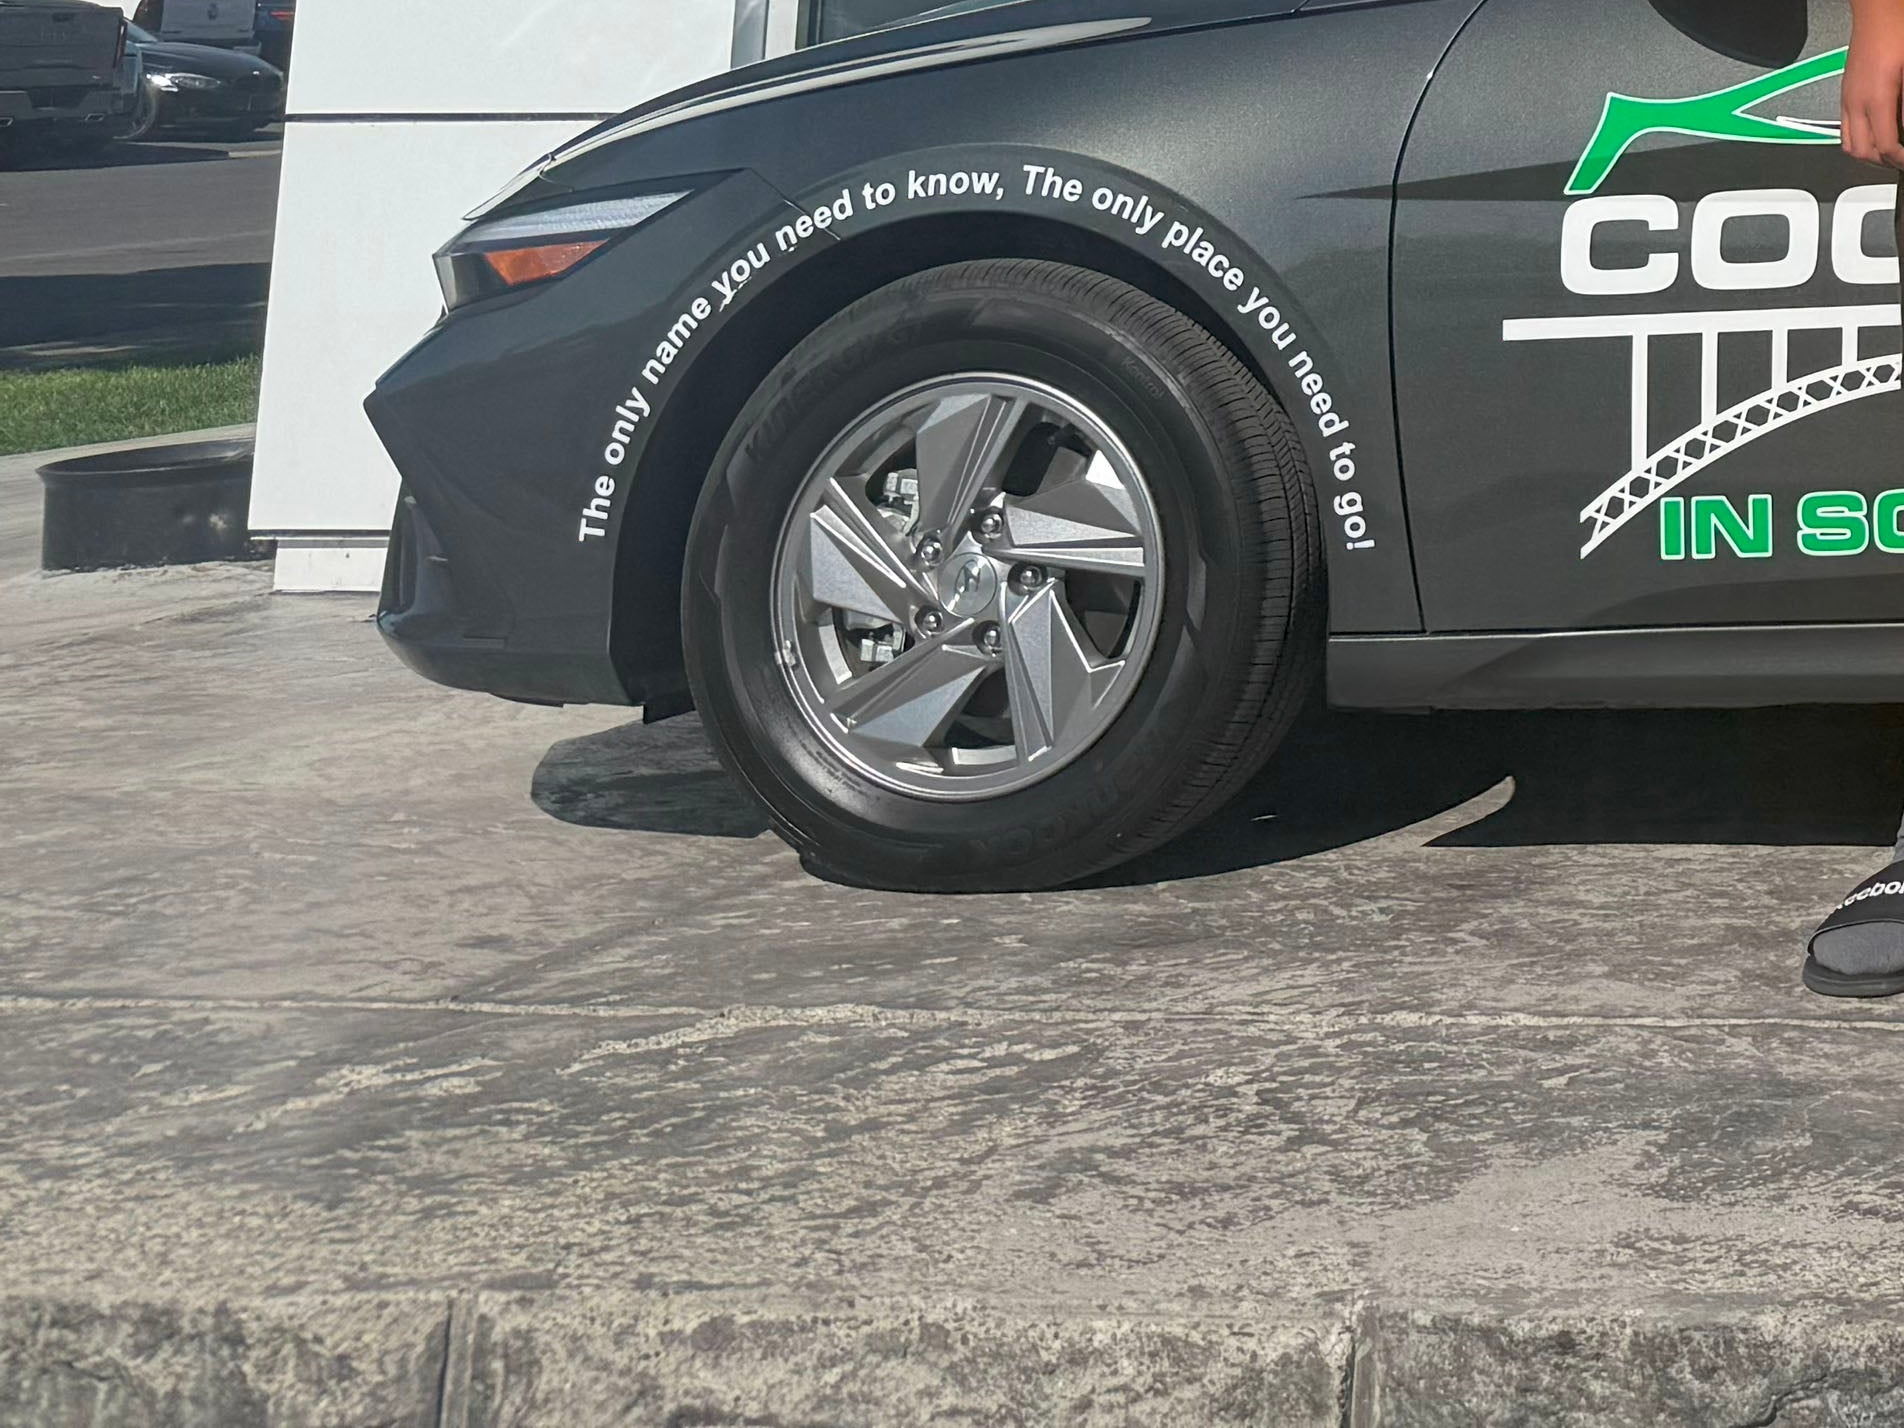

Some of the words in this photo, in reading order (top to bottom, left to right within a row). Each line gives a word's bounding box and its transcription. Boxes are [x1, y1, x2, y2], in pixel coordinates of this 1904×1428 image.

[862, 183, 895, 209] to
[908, 170, 1003, 200] know,
[1023, 165, 1082, 201] The
[1092, 188, 1164, 234] only
[776, 189, 853, 250] need
[712, 243, 770, 311] you
[1162, 221, 1243, 290] place
[642, 298, 711, 384] name
[1237, 287, 1296, 350] you
[1289, 351, 1349, 437] need
[605, 387, 650, 465] only
[1330, 442, 1355, 480] to
[579, 476, 614, 541] The
[1334, 492, 1374, 548] go!
[1659, 493, 1773, 561] IN
